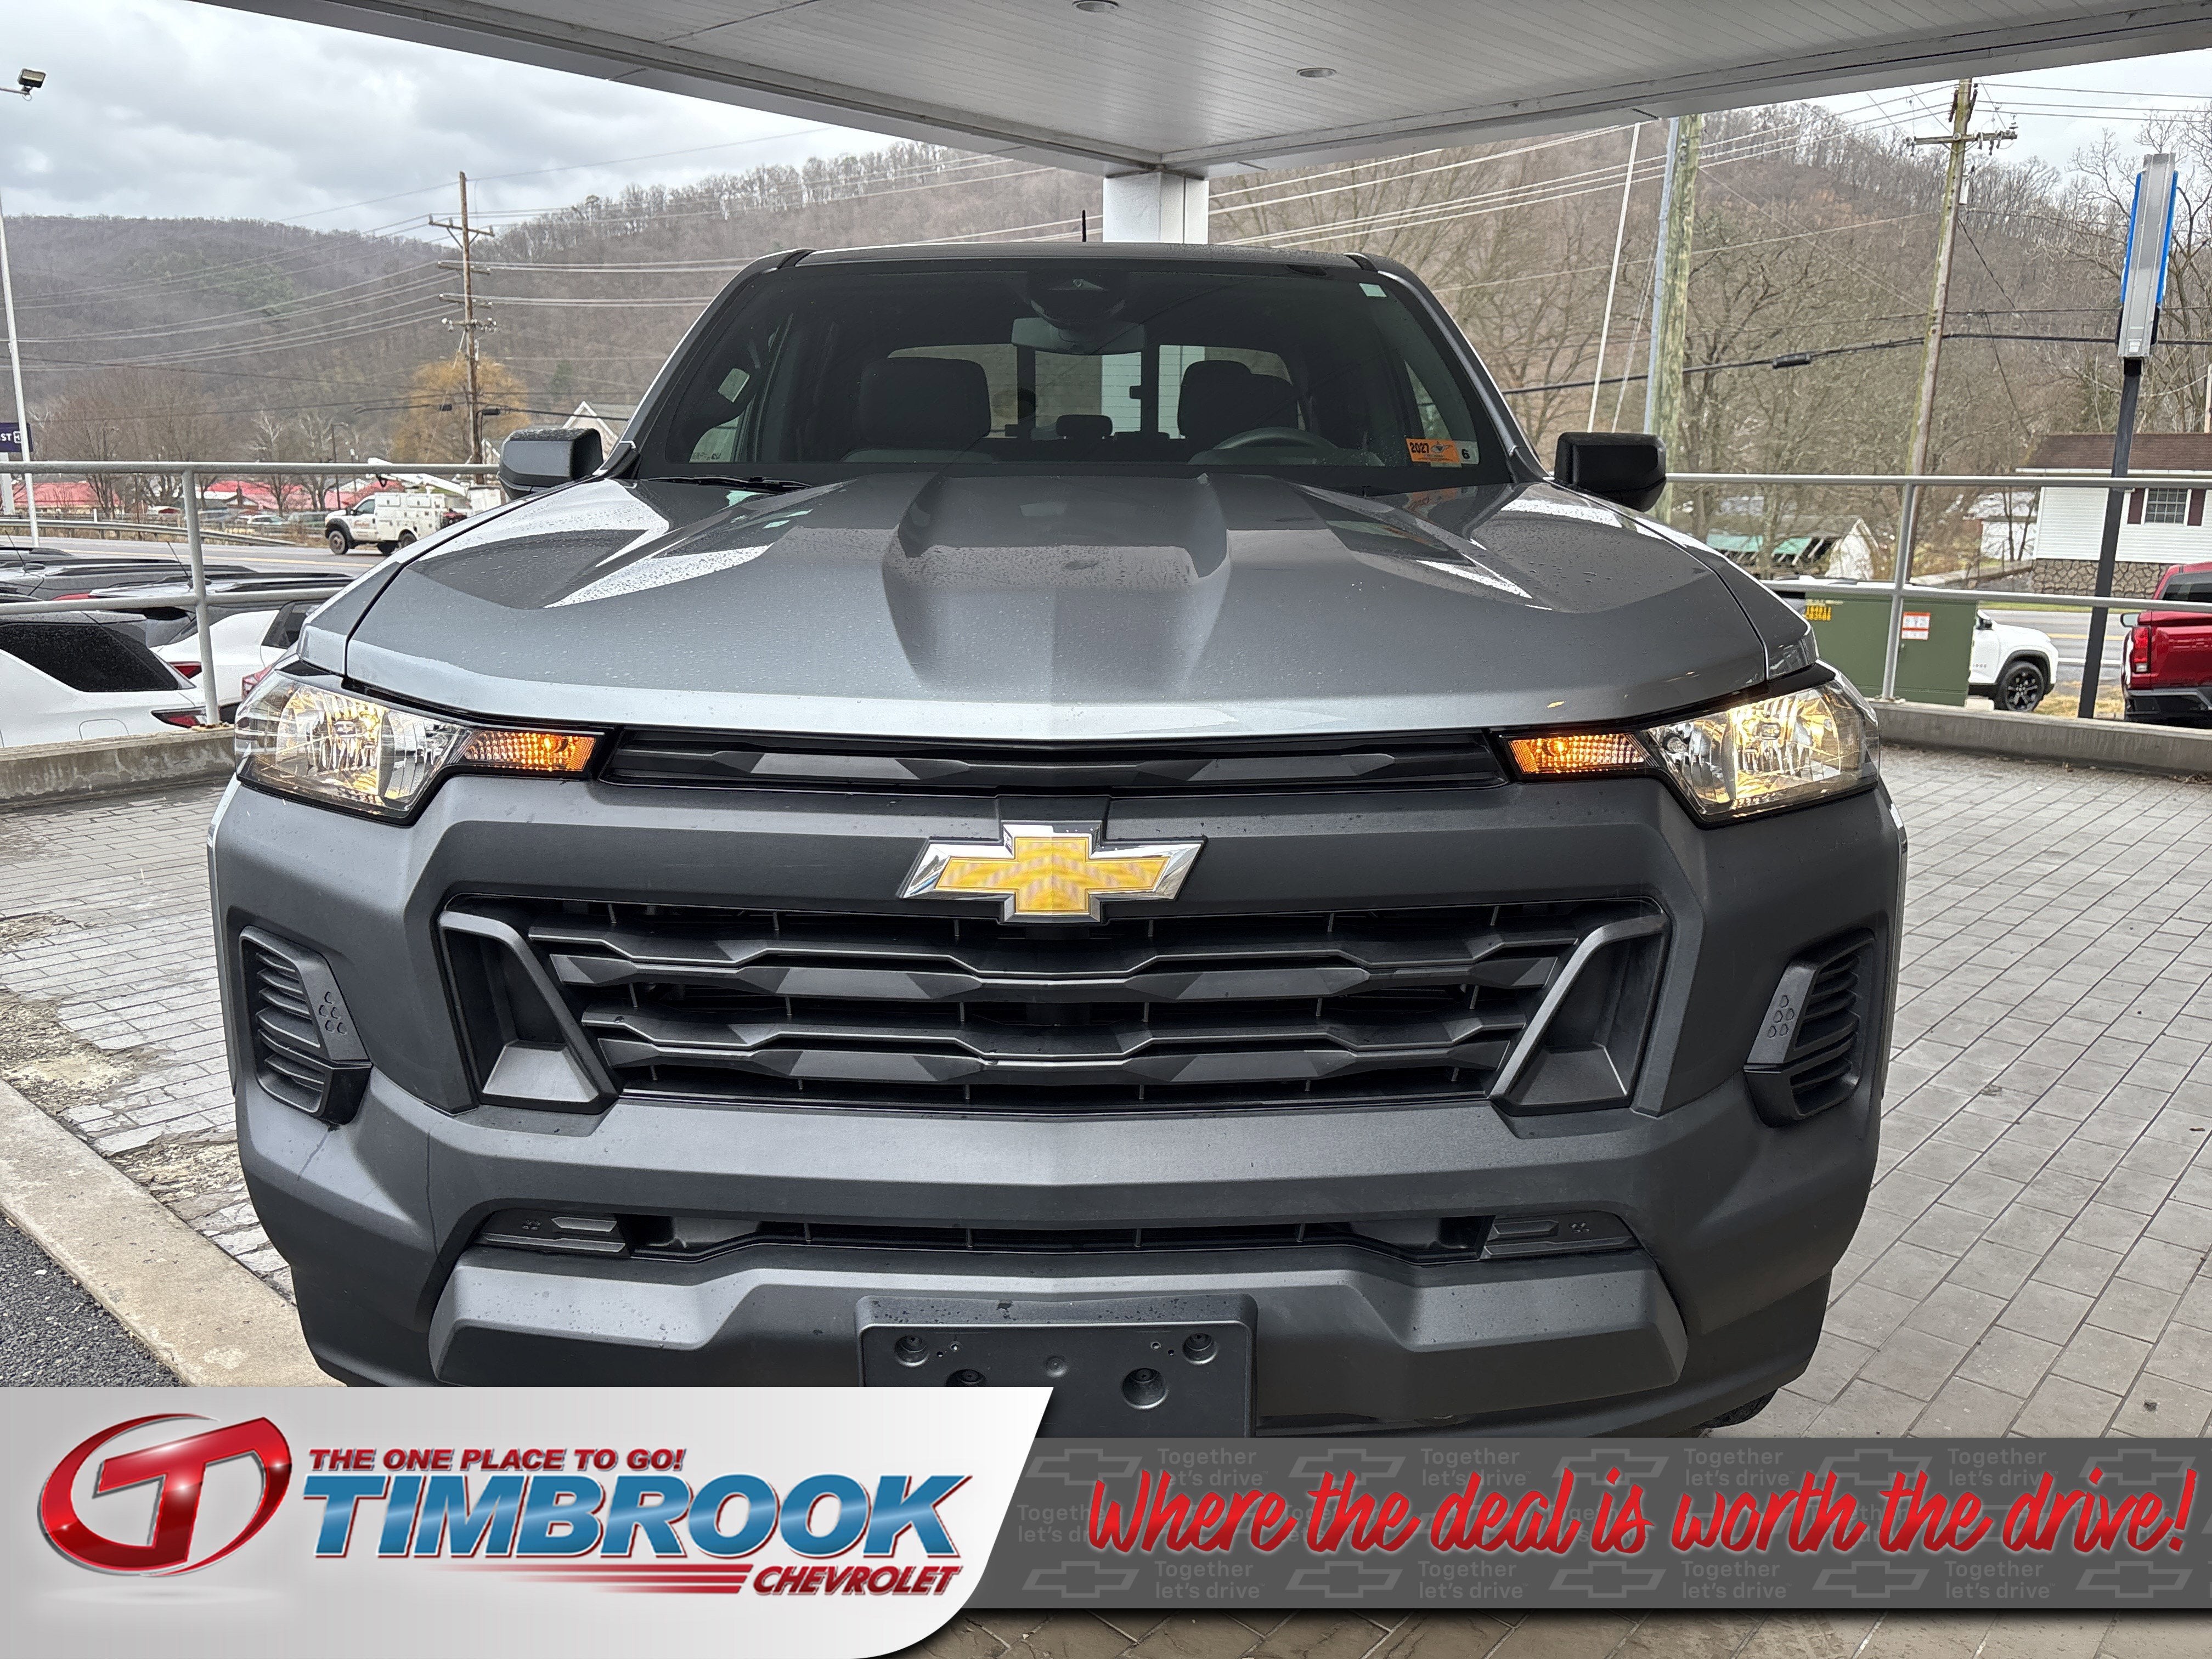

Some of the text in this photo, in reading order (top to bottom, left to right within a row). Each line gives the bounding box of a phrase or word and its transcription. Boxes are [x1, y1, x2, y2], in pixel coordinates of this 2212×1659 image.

[0, 433, 12, 442] ST
[1409, 442, 1430, 454] 2027
[1462, 448, 1470, 459] 6
